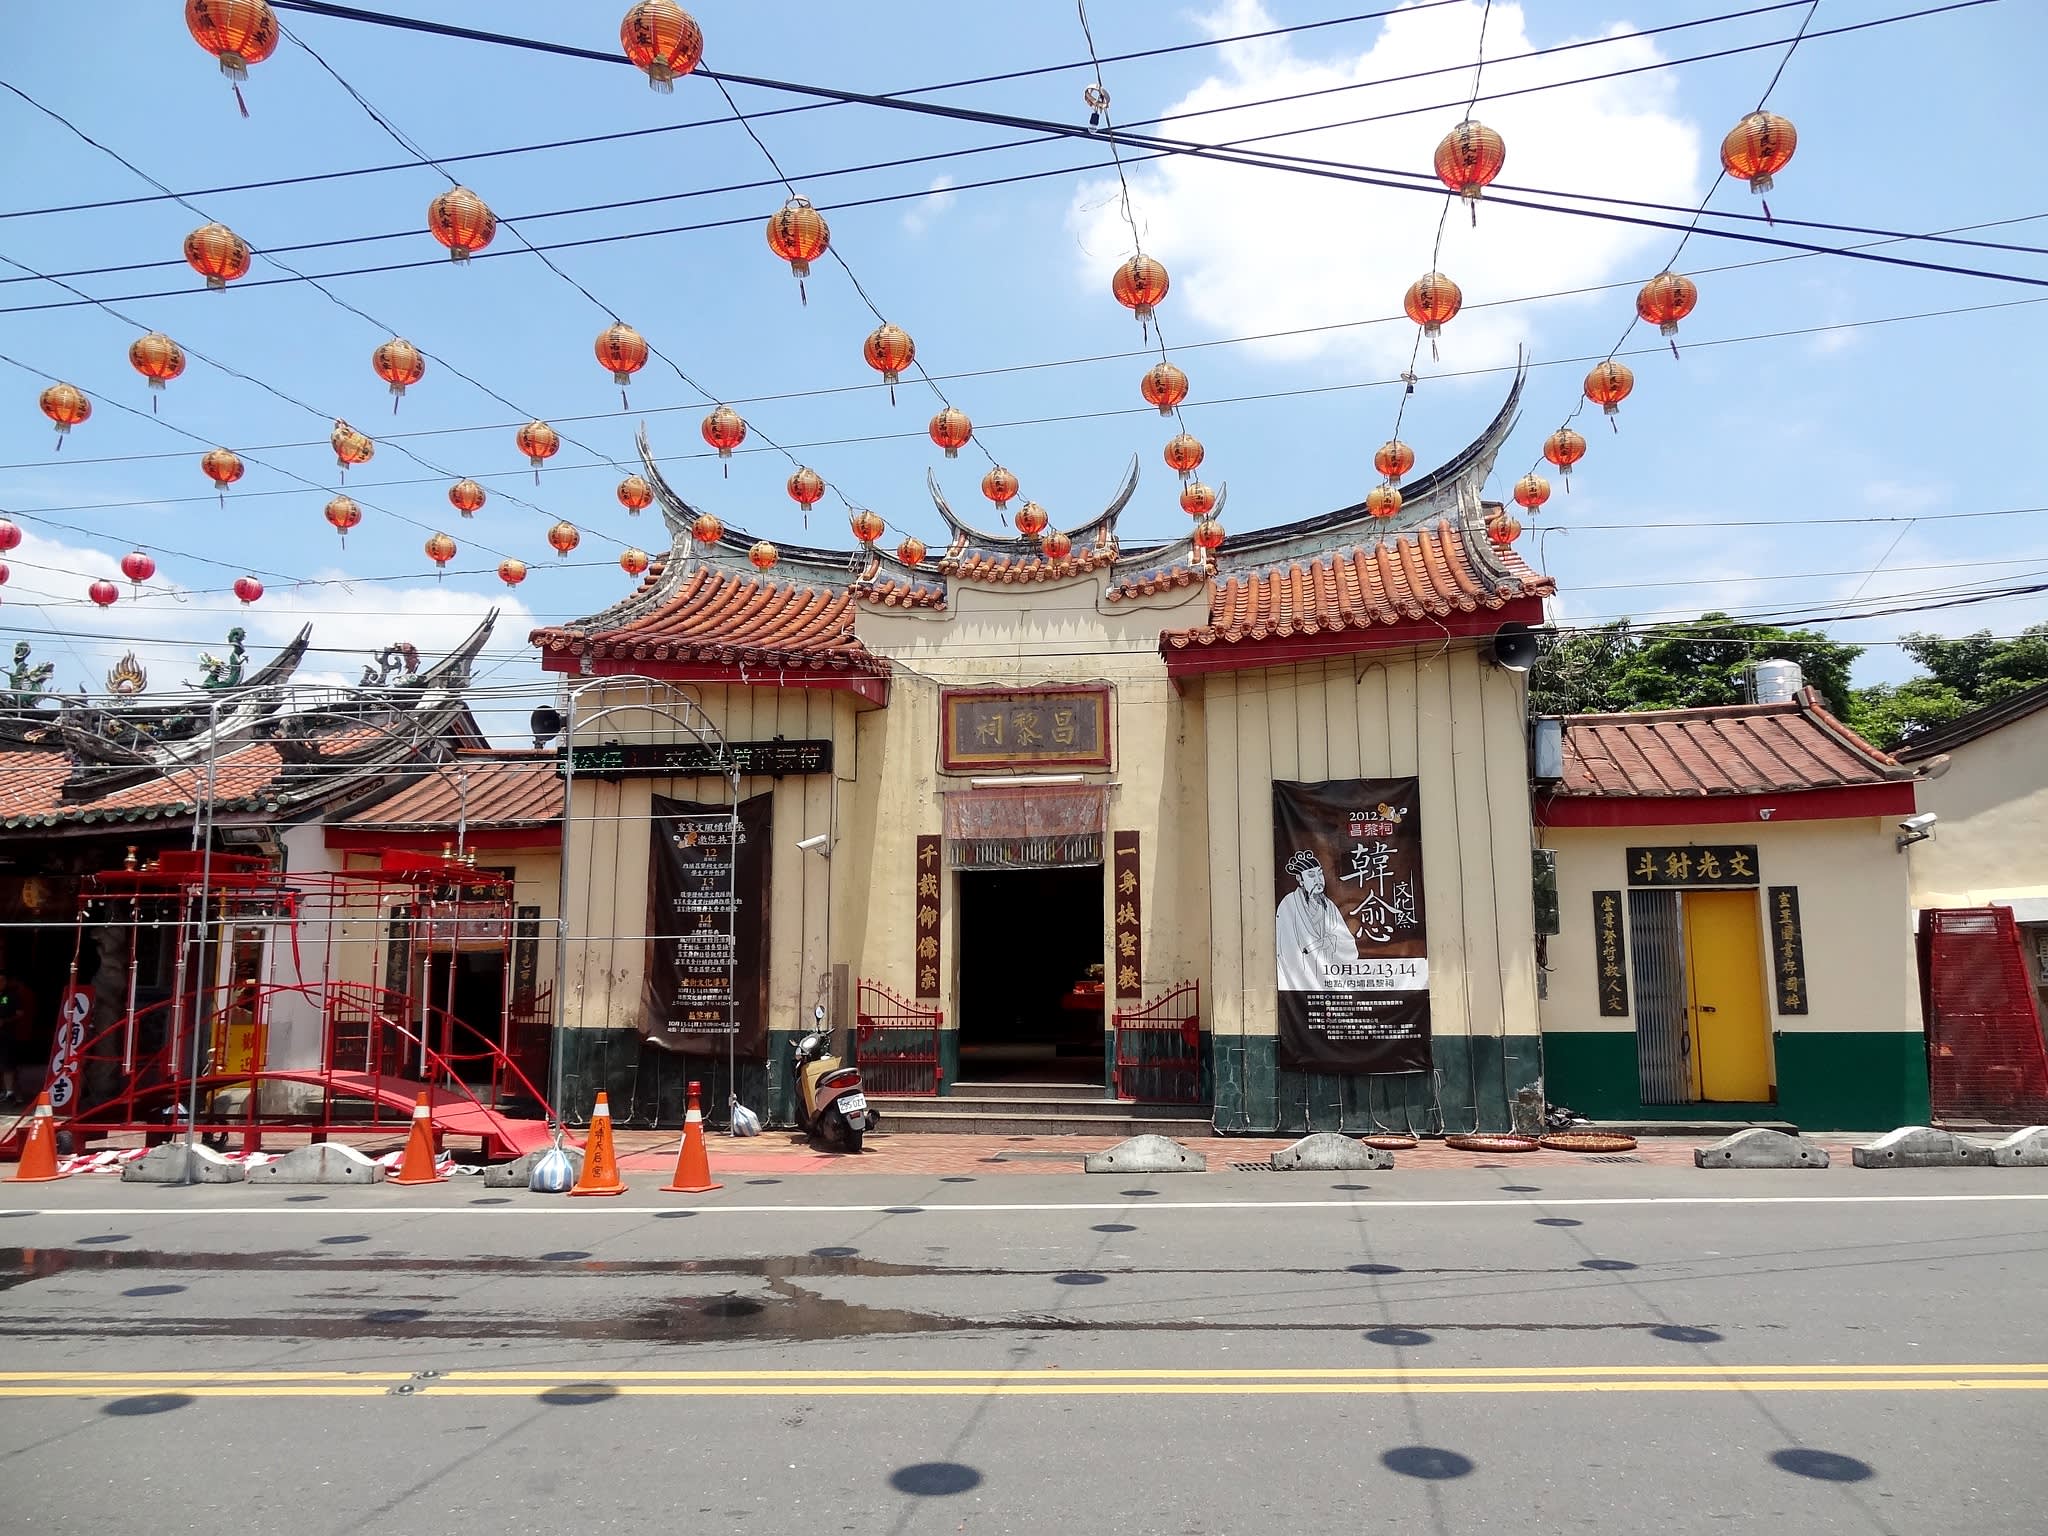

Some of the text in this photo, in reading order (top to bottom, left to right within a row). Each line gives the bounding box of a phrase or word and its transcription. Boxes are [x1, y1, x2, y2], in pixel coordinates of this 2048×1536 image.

[976, 708, 1075, 746] 昌黎祠
[1349, 811, 1379, 822] 2012
[1350, 822, 1394, 837] 昌黎祠
[704, 848, 718, 857] 12
[1635, 850, 1755, 881] 文光射斗
[703, 877, 715, 886] 13
[1339, 841, 1403, 942] 韓愈
[1395, 881, 1419, 929] 文化祭
[699, 914, 713, 923] 14
[917, 843, 939, 991] 千載仰儒宗
[1116, 847, 1140, 990] 一身扶聖教
[1322, 963, 1417, 978] 10月12/13/14
